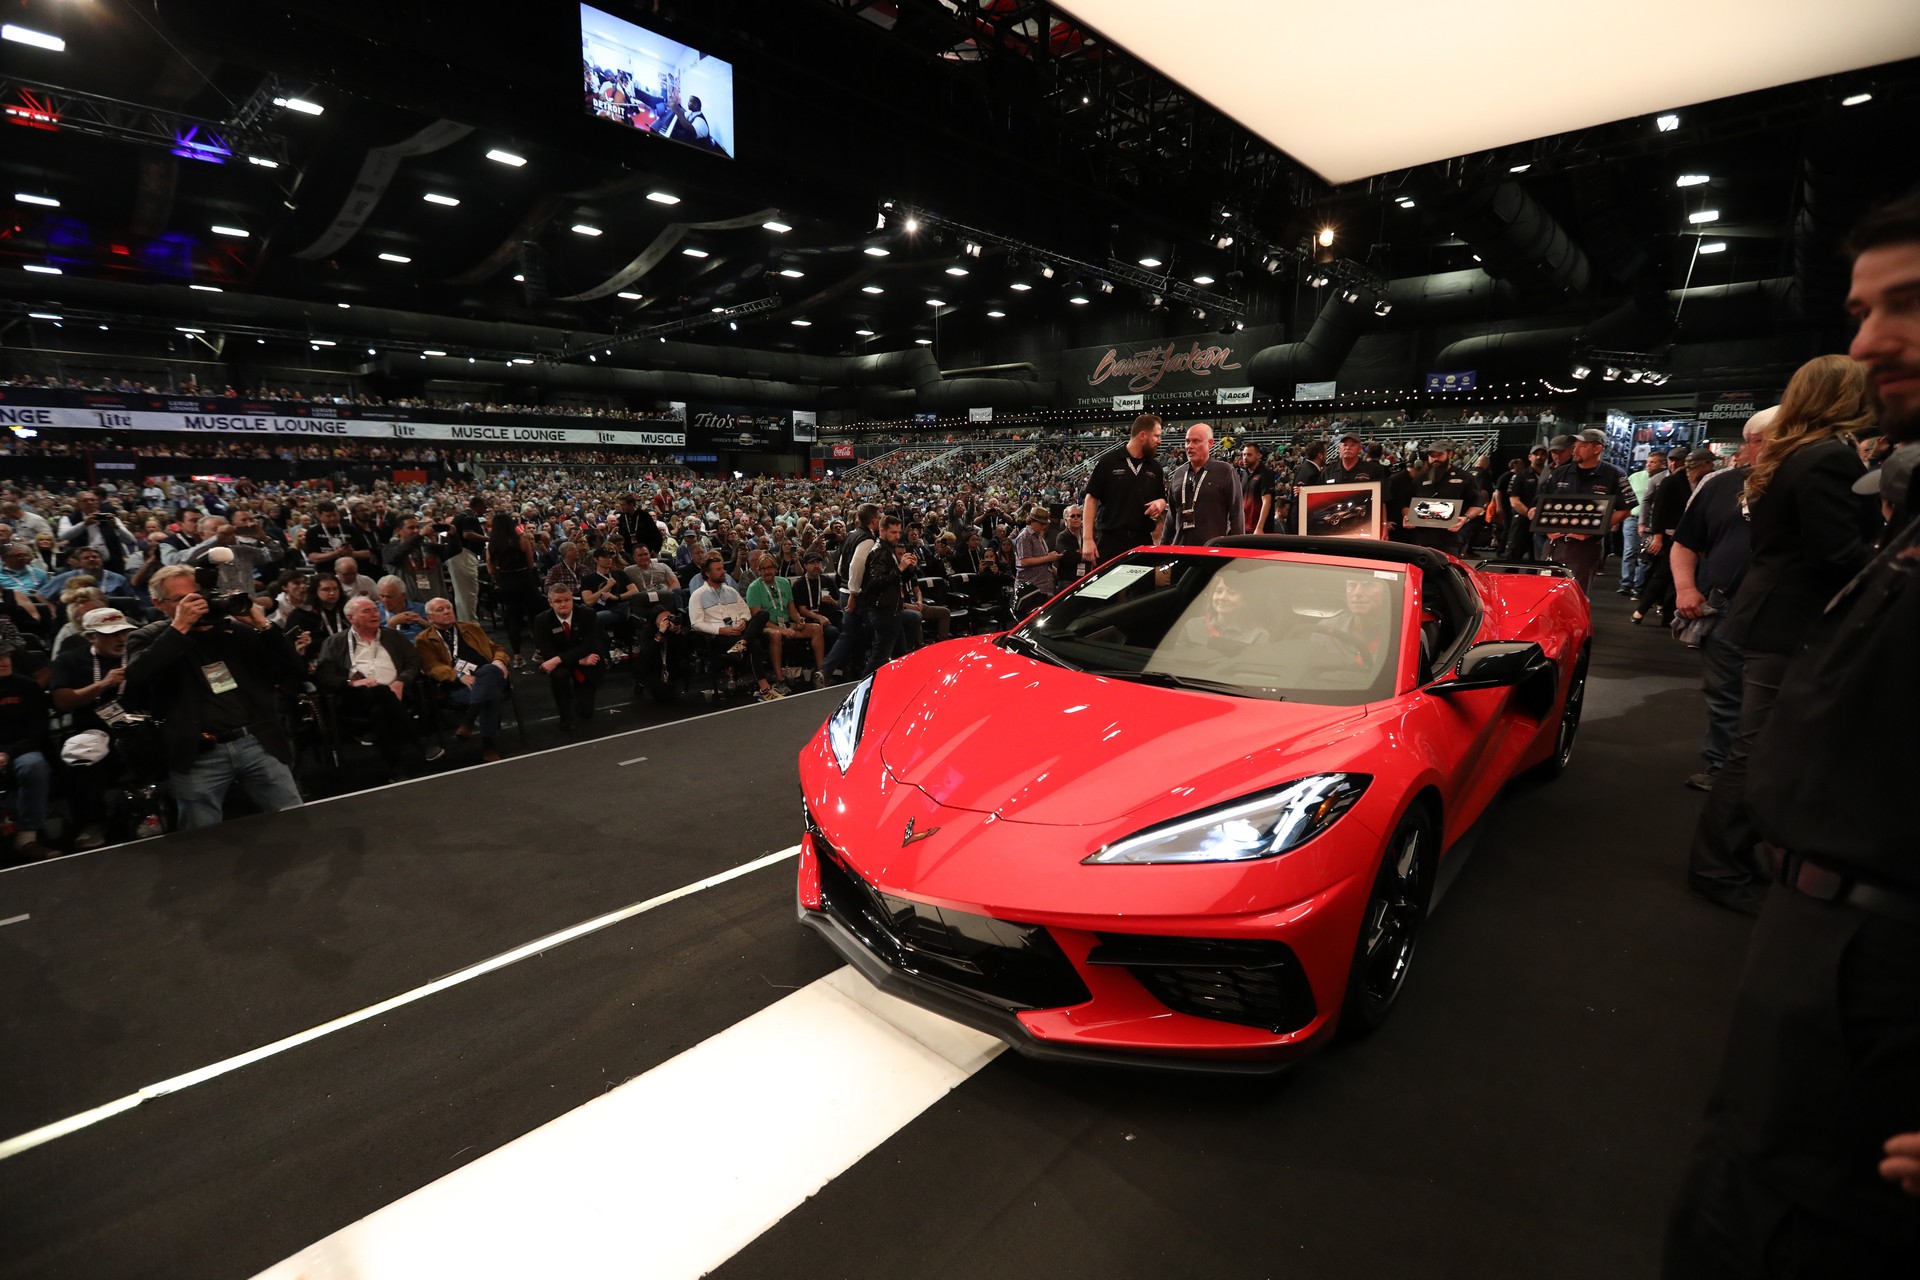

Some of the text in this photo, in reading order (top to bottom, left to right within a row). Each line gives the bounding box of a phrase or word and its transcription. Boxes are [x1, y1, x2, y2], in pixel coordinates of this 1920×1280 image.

[593, 98, 625, 115] DETROIT
[1091, 396, 1113, 404] WORLD
[1152, 390, 1193, 400] COLLECTOR
[1194, 389, 1210, 398] CAR
[1712, 403, 1756, 412] OFFICIAL
[0, 409, 52, 425] NGE
[98, 412, 132, 428] Lite
[694, 411, 735, 429] Tito's
[1698, 410, 1757, 420] MERCHAND
[185, 416, 347, 434] MUSCLE LOUNGE
[392, 423, 415, 437] Lite
[451, 427, 566, 441] MUSCLE LOUNGE
[596, 431, 615, 444] Lite
[641, 434, 684, 444] MUSCLE
